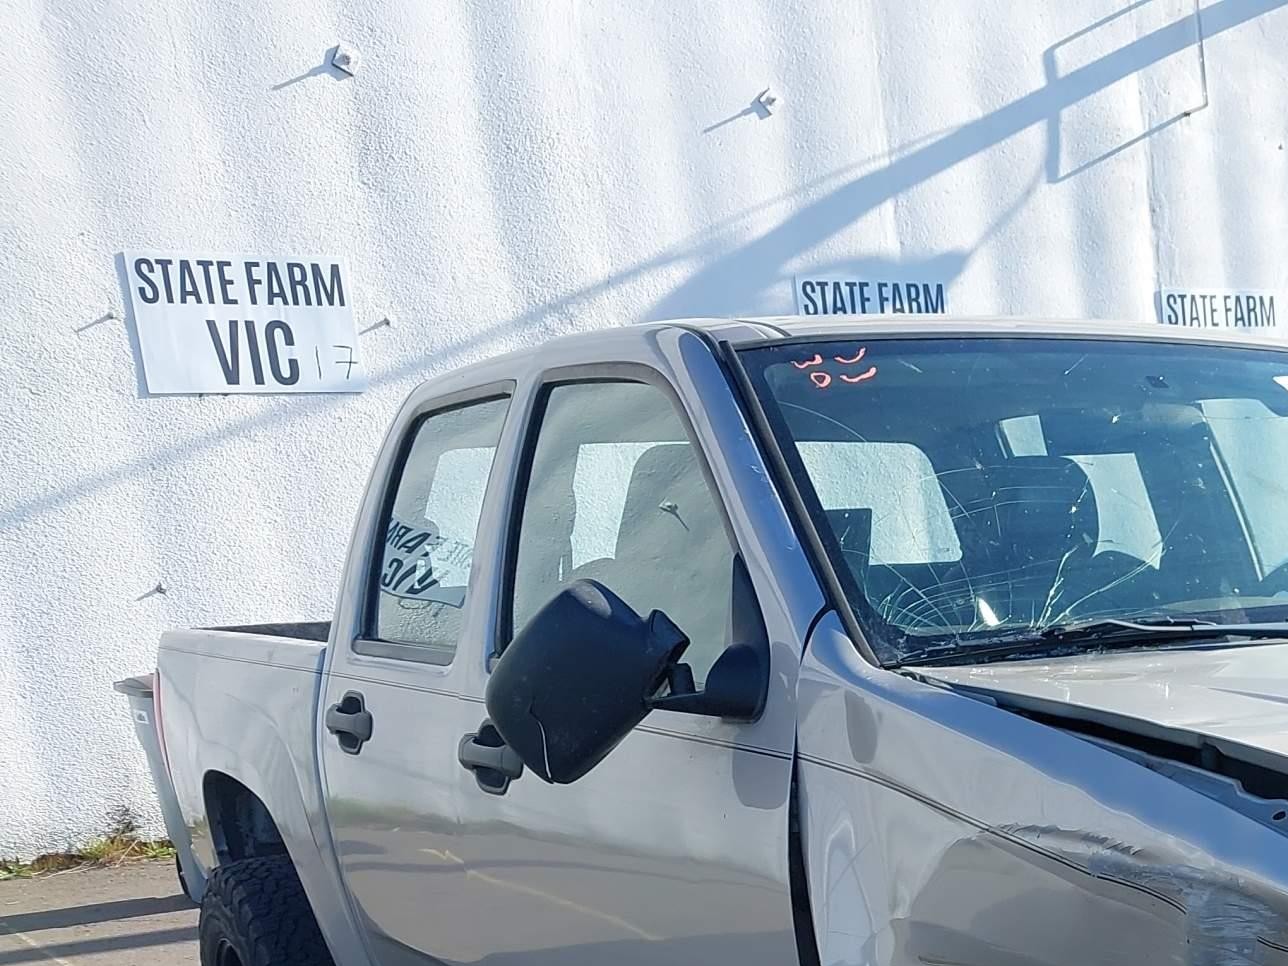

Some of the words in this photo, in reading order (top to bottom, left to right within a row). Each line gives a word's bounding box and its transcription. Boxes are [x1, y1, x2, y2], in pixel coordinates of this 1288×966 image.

[134, 257, 239, 305] STATE
[243, 261, 346, 307] FARM
[801, 280, 871, 315] STATE
[877, 282, 946, 315] FARM
[1166, 294, 1220, 328] STATE
[1223, 295, 1276, 328] FARM
[205, 319, 300, 386] VIC
